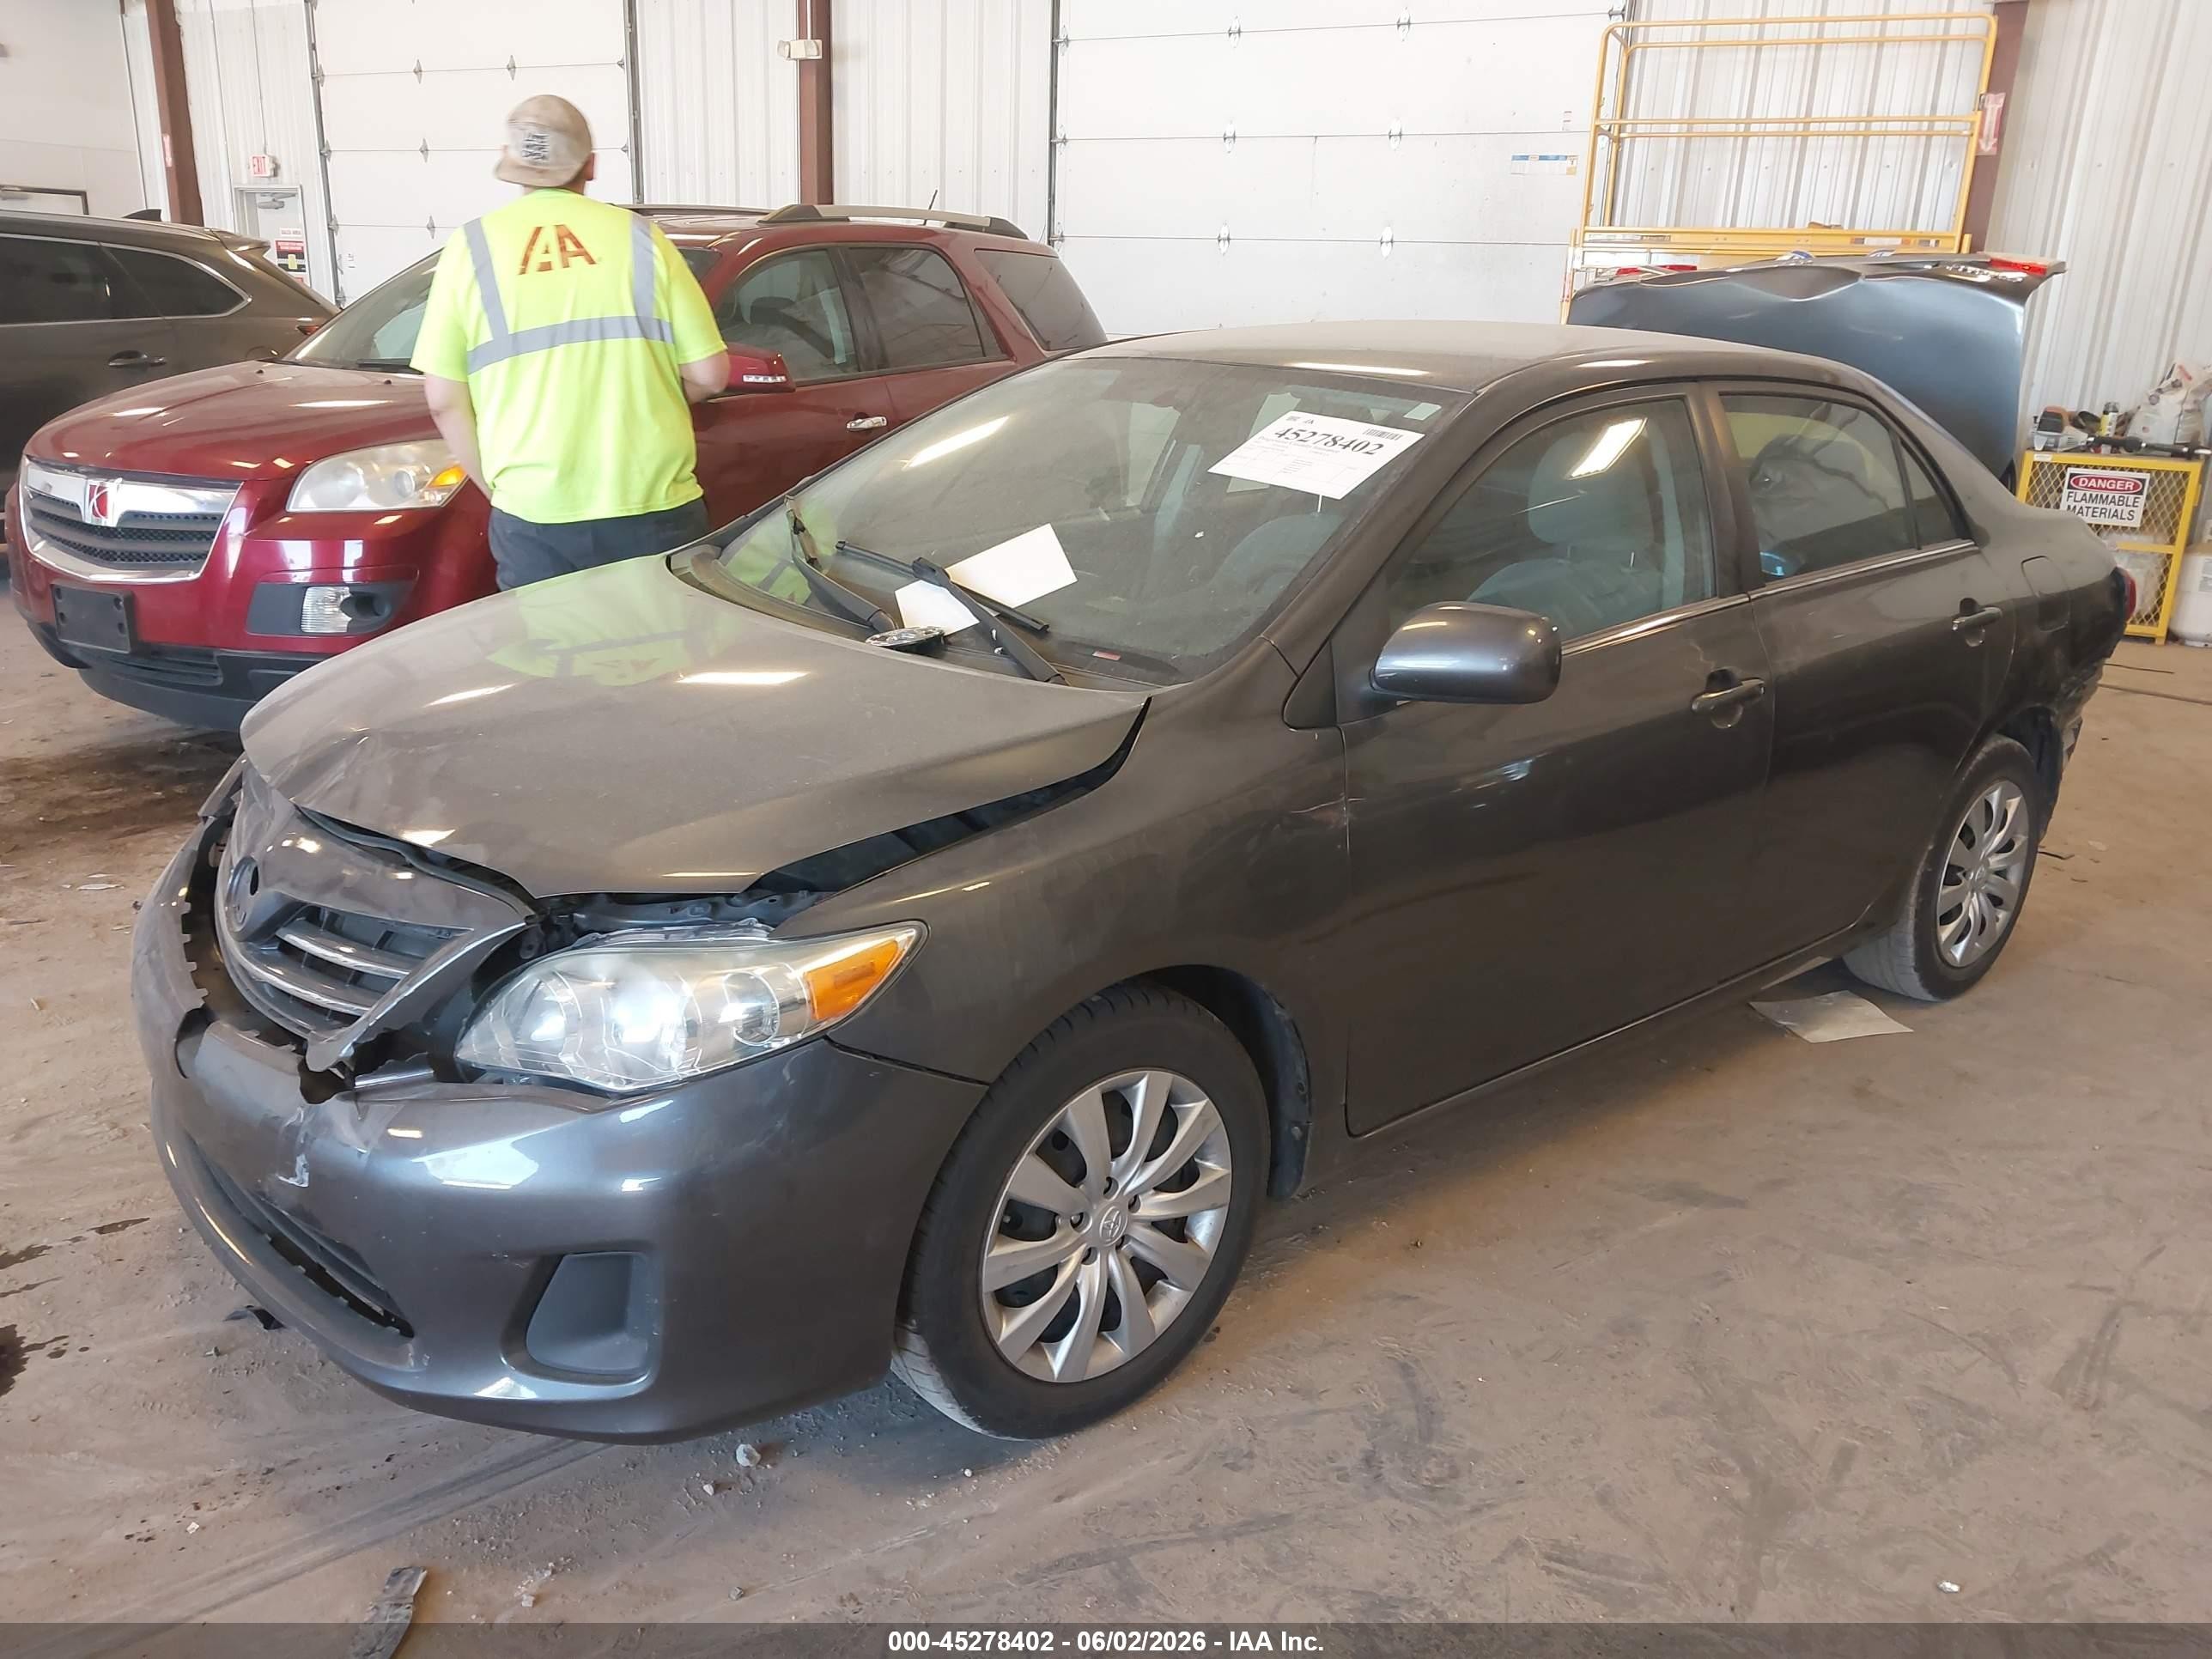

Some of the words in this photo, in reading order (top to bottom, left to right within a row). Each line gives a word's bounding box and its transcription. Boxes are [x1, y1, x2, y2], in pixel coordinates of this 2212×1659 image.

[1274, 428, 1384, 455] 45278402
[2078, 477, 2135, 490] DANGER
[2066, 491, 2141, 507] FLAMMABLE
